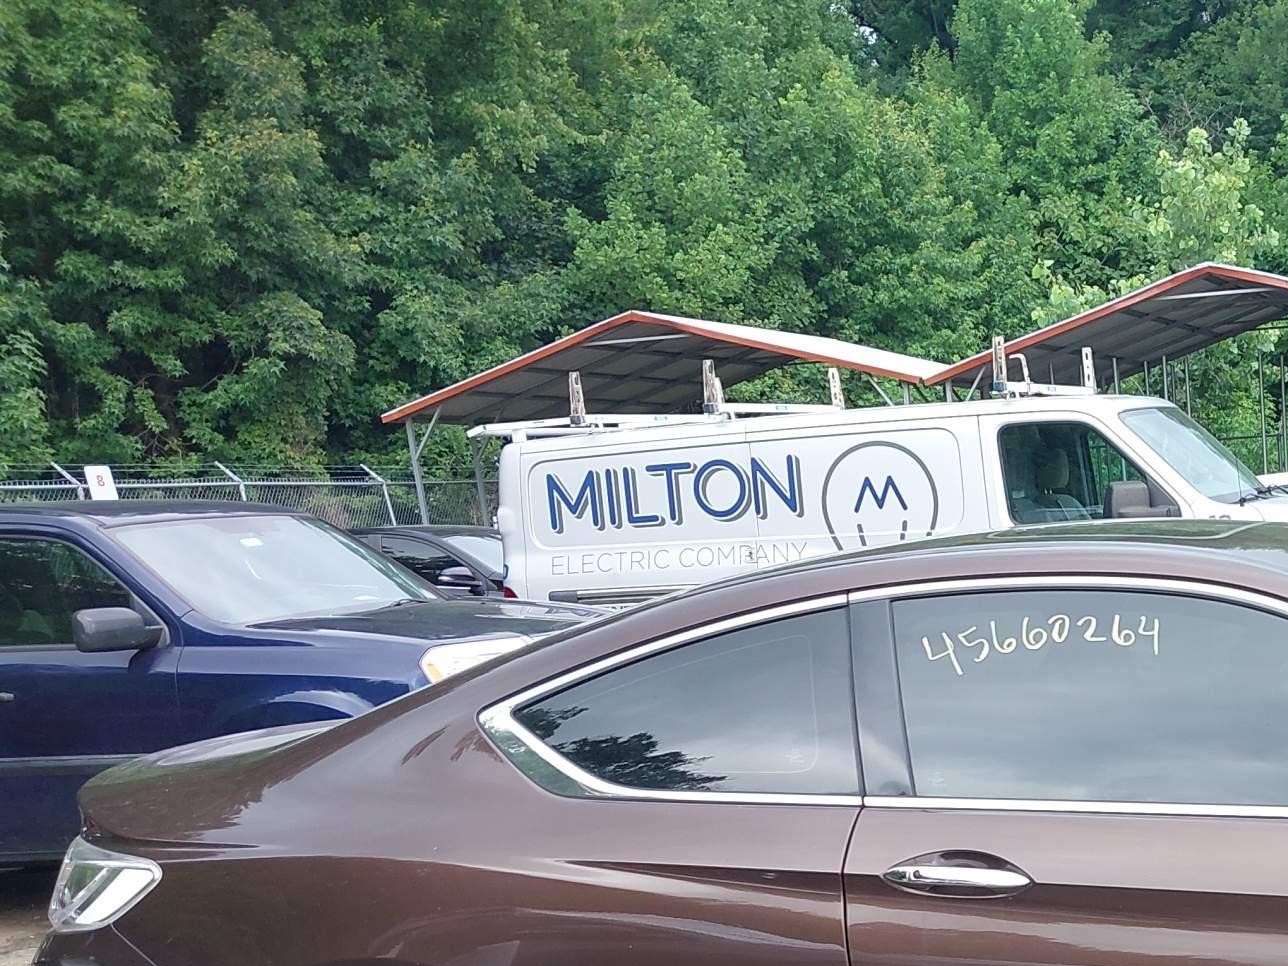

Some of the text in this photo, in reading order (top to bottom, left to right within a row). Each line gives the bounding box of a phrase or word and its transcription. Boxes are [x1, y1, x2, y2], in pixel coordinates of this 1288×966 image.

[96, 474, 105, 487] 8
[545, 453, 806, 534] MILTON
[550, 541, 808, 576] ELECTRIC COMPANY
[921, 613, 1160, 676] 45660264
